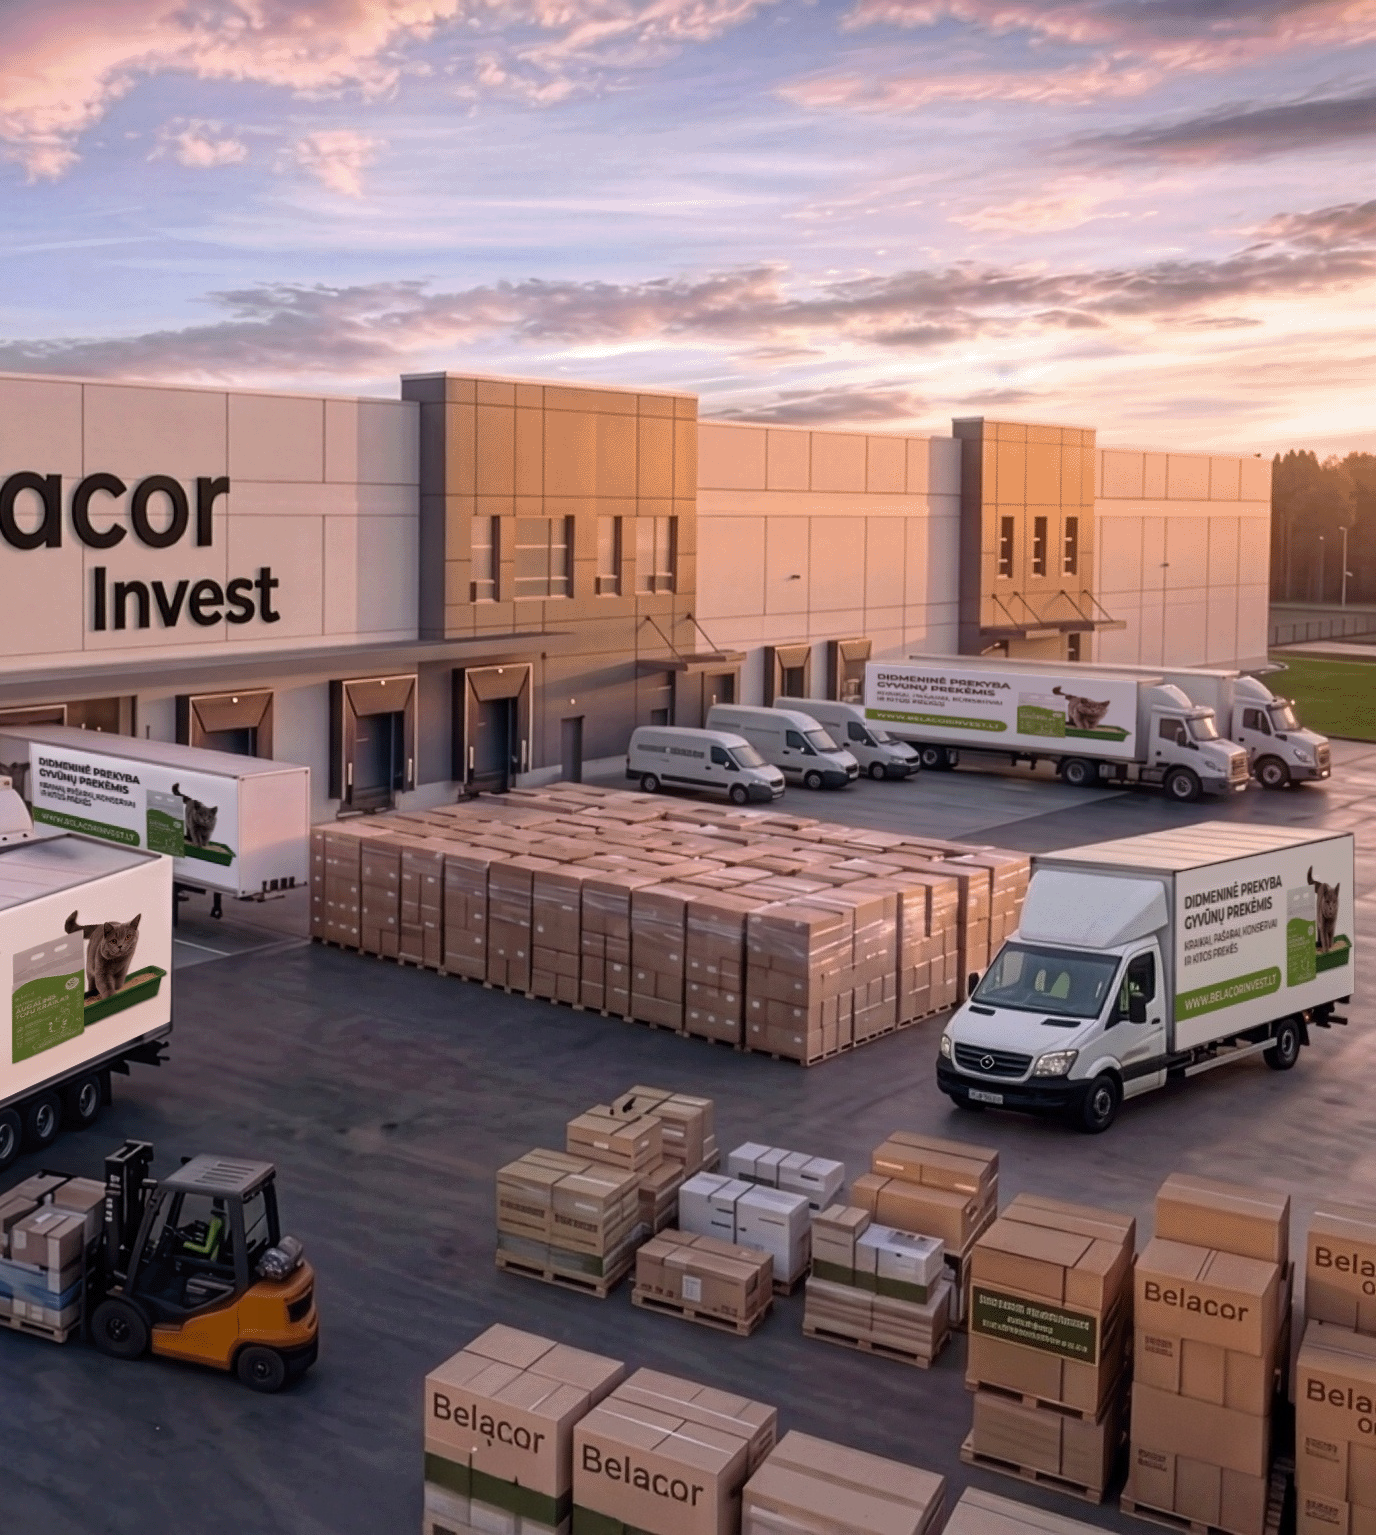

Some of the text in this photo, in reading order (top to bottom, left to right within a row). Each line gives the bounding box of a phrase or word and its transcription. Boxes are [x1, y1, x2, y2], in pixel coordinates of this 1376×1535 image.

[91, 566, 281, 632] Invest
[1184, 875, 1282, 909] DIDMENINĖ PREKYBA
[1227, 896, 1273, 920] PREKĖMIS
[1144, 1280, 1249, 1322] Belacor
[433, 1392, 545, 1454] Belacor
[582, 1443, 704, 1507] Belacor
